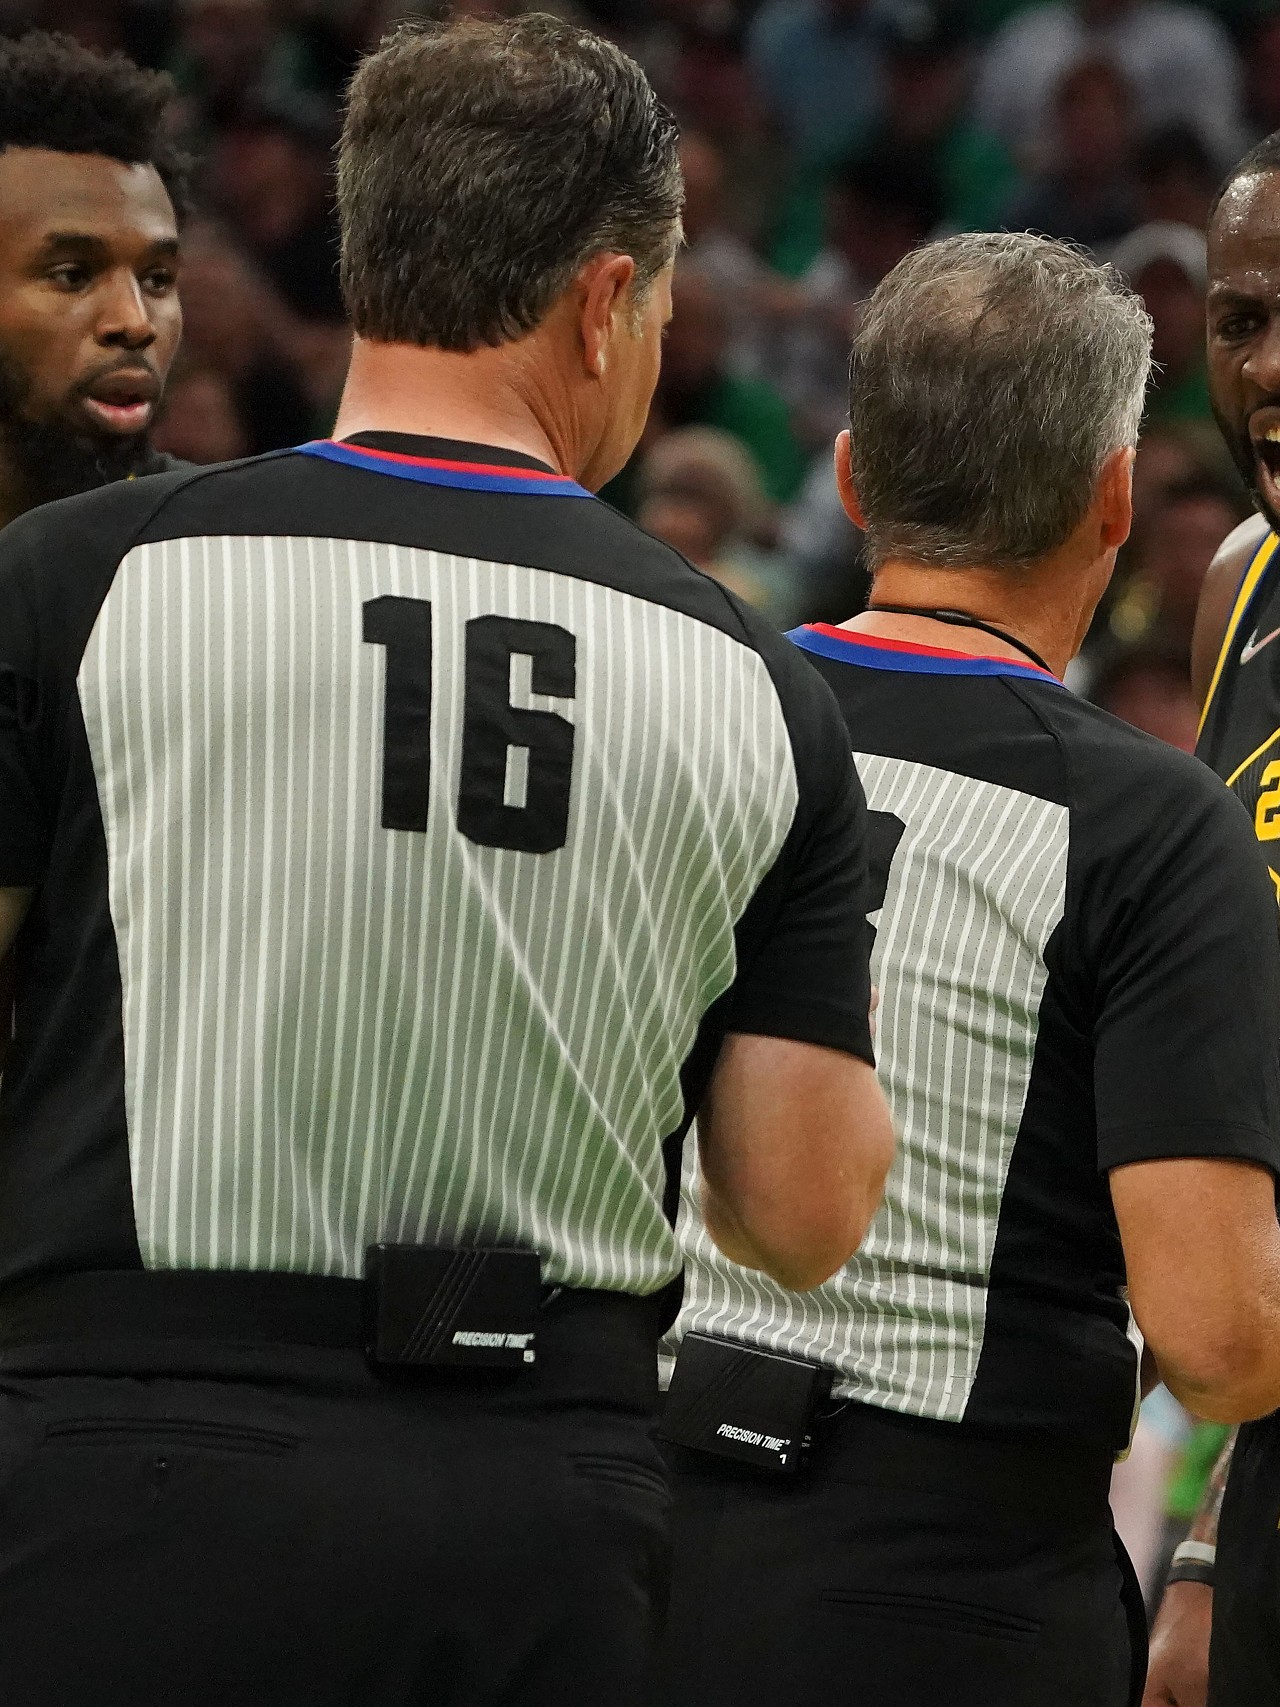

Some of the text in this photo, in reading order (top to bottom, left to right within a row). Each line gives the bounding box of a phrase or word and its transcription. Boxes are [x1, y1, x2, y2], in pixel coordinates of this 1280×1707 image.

[362, 595, 576, 854] 16
[716, 1423, 764, 1446] PRECISION
[780, 1454, 787, 1465] 1
